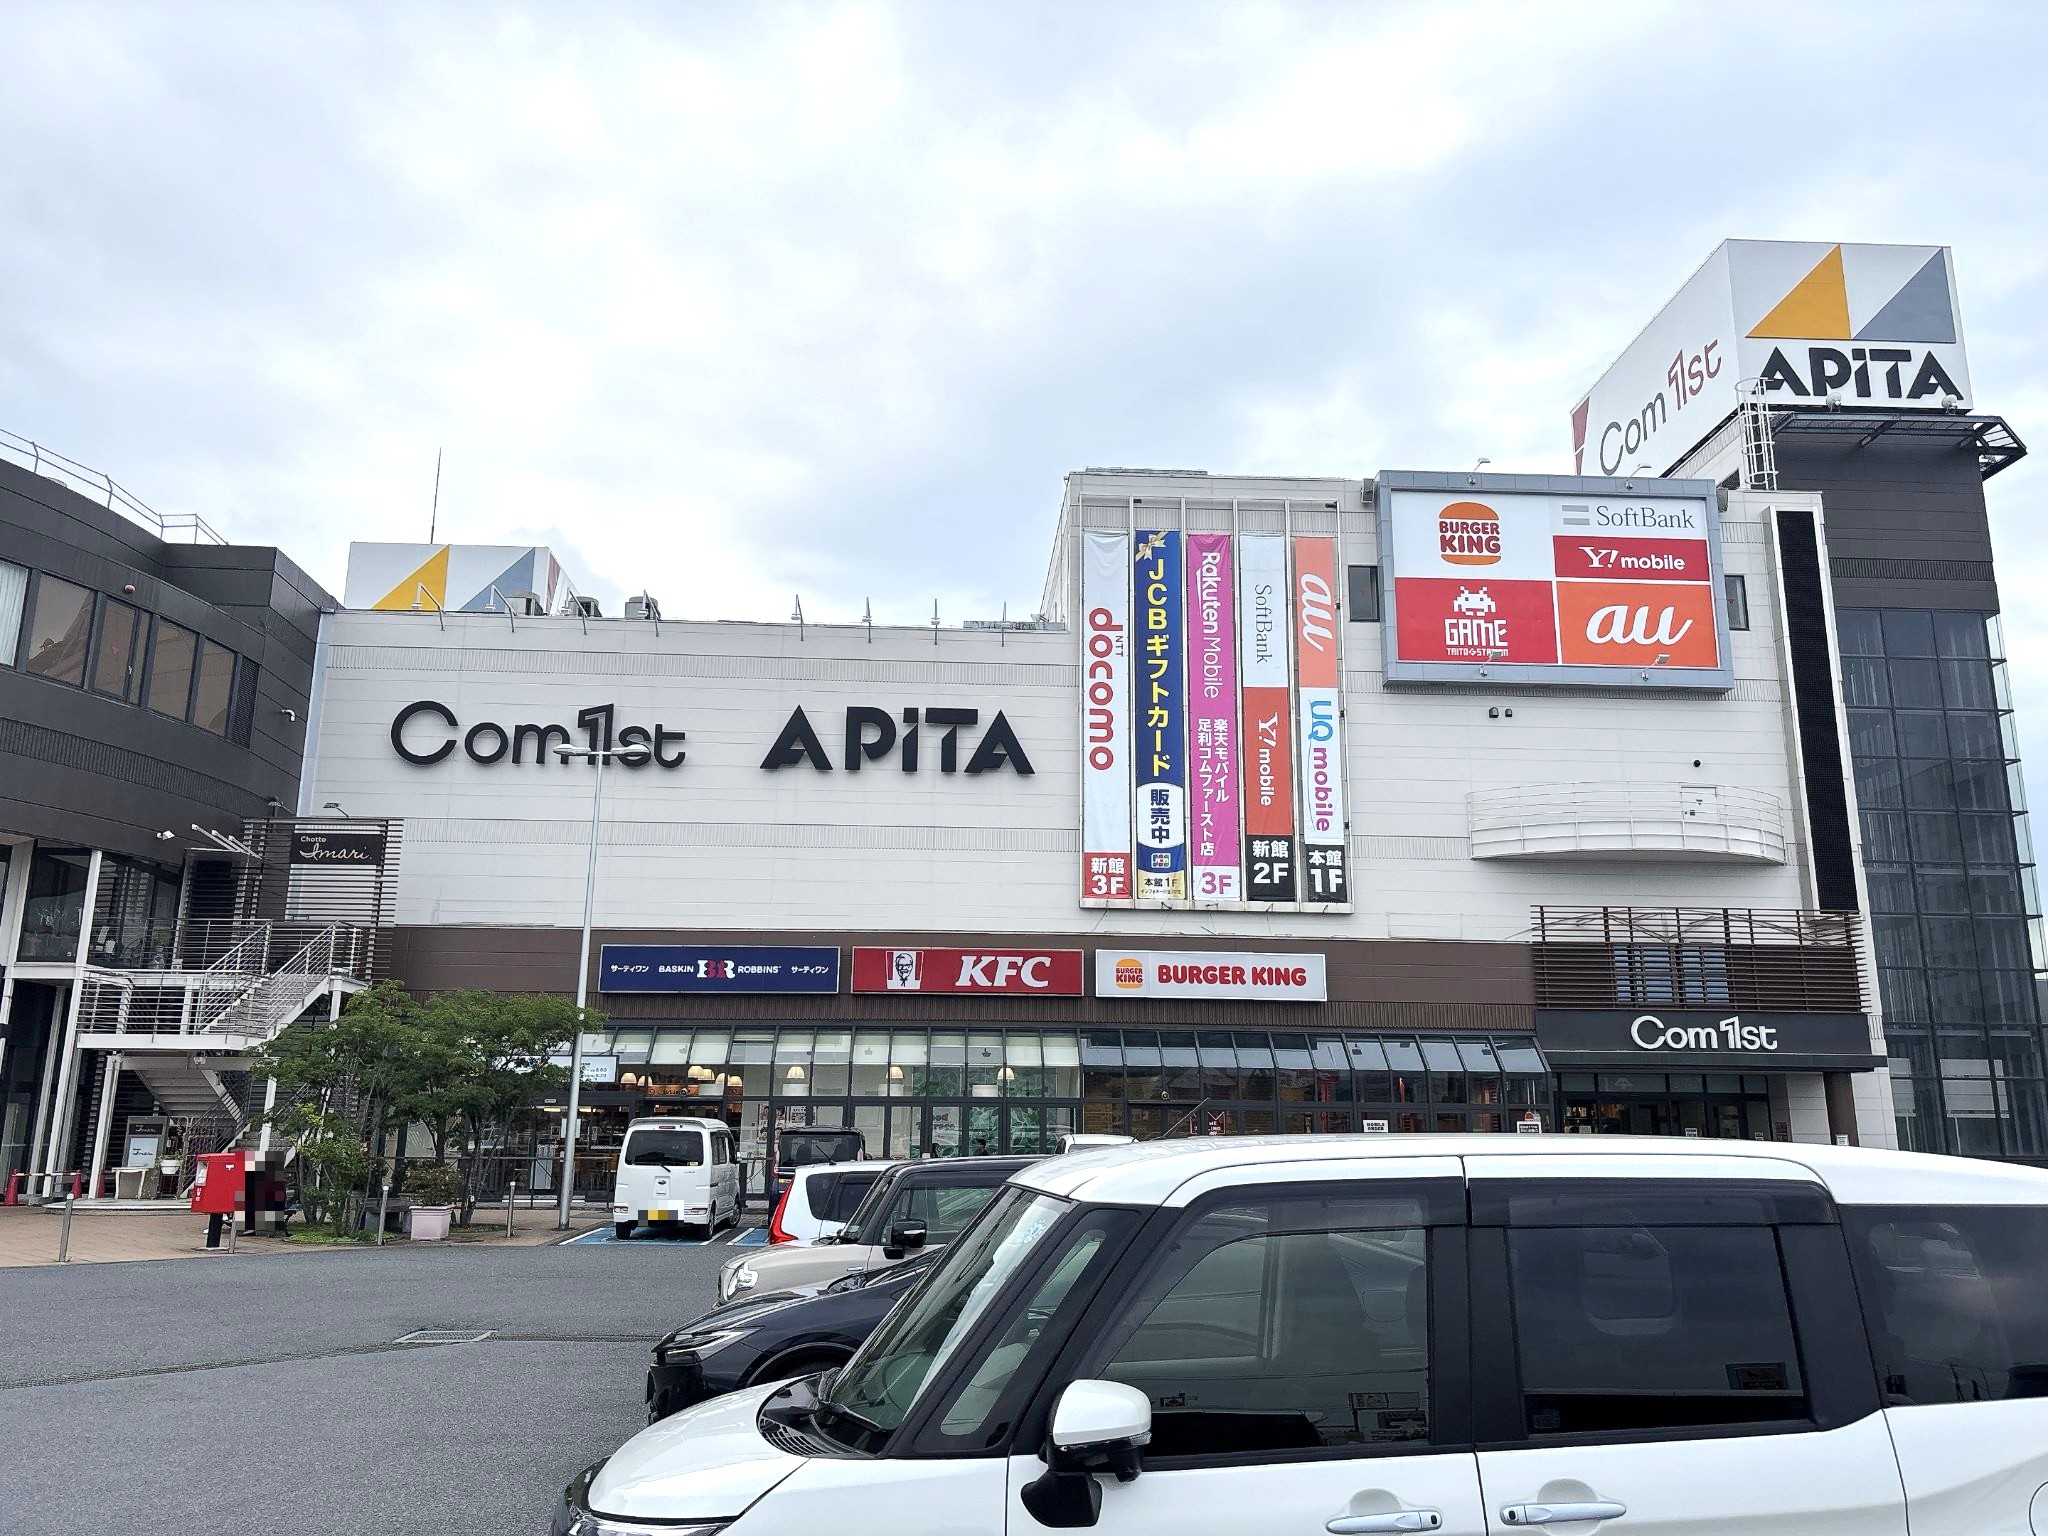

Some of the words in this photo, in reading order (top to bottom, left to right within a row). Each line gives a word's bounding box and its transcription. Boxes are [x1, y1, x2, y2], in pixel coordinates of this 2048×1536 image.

[1439, 521, 1500, 535] BURGER
[1596, 505, 1695, 529] SoftBank
[1440, 534, 1501, 554] KING
[1198, 552, 1222, 633] Rakuten
[1254, 583, 1273, 665] SoftBank
[1300, 572, 1333, 653] au
[1445, 619, 1508, 646] GAME
[1586, 604, 1694, 645] au
[1115, 635, 1123, 657] NTT
[1203, 636, 1223, 699] Mobile
[1089, 607, 1123, 771] docomo
[1307, 700, 1333, 742] UQ
[1213, 718, 1229, 803] 楽天モバイル
[1198, 718, 1215, 856] 足利コムファースト店
[1312, 747, 1332, 832] mobile
[1150, 789, 1171, 843] 販売中
[1252, 839, 1289, 858] 新館
[1308, 849, 1342, 867] 本館
[1091, 857, 1125, 874] 新館
[1253, 862, 1288, 885] 2F
[1091, 874, 1125, 894] 3F
[1201, 871, 1232, 894] 3F
[1310, 868, 1343, 893] 1F
[611, 964, 650, 973] サーティワン
[658, 965, 694, 973] BASKIN
[737, 965, 779, 974] ROBBINS
[791, 965, 829, 974] サーティワン
[954, 955, 1052, 988] KFC
[1115, 967, 1143, 975] BURGER
[1115, 974, 1144, 984] KING
[1157, 964, 1246, 985] BURGER
[1251, 966, 1307, 987] KING
